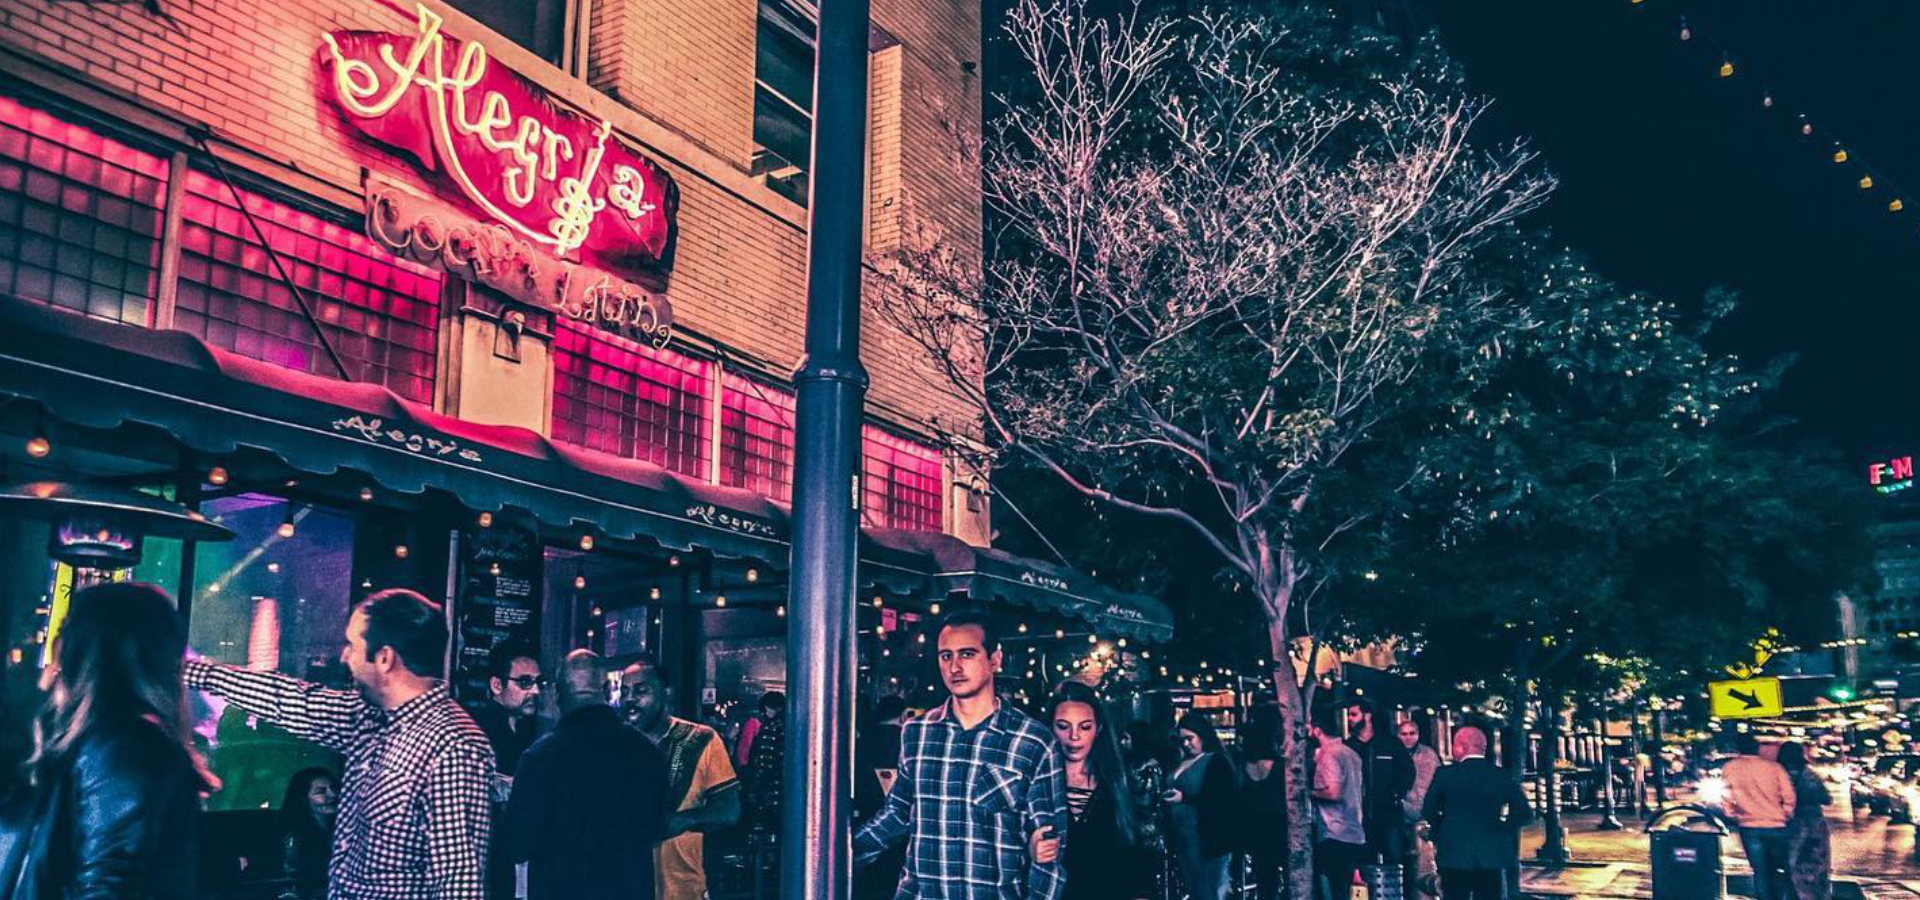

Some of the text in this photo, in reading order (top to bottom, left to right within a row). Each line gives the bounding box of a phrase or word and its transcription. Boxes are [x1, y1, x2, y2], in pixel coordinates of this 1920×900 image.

[322, 3, 656, 256] Alegria
[371, 188, 672, 350] Cocina Latina
[332, 415, 482, 462] Alegria
